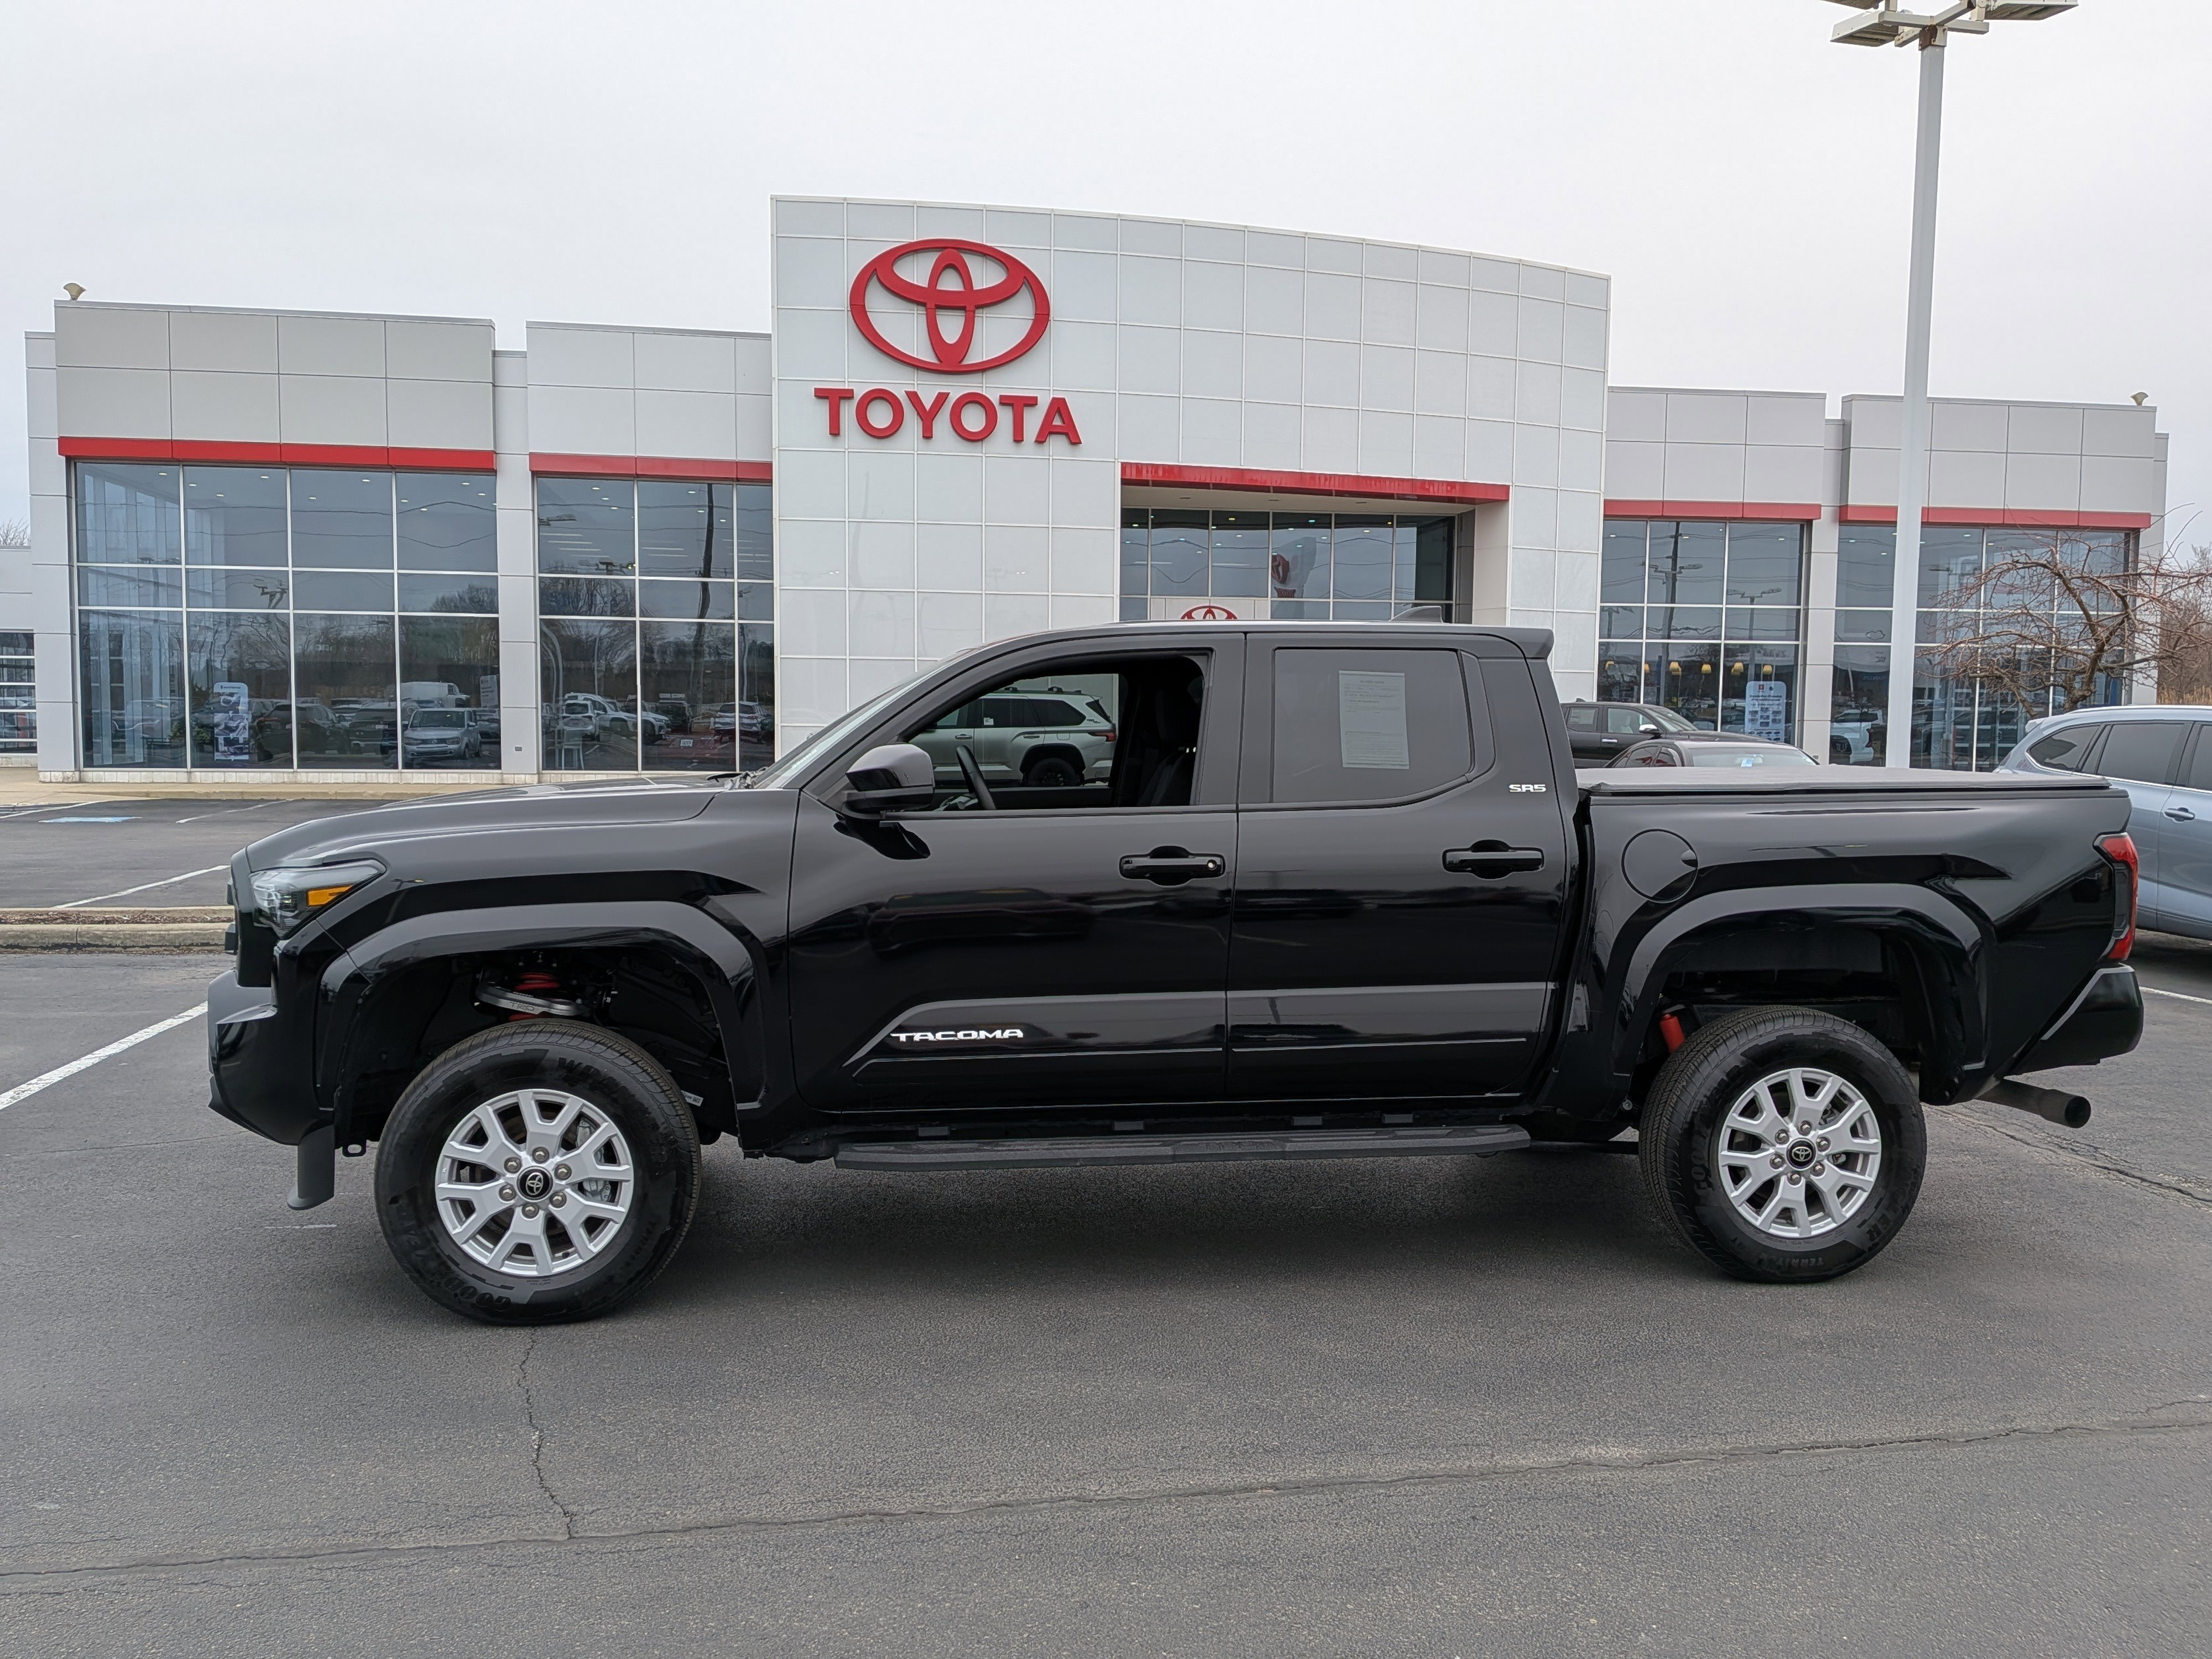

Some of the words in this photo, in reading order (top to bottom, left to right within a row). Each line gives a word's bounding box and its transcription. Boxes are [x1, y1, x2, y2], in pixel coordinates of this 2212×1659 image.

[814, 388, 1082, 445] TOYOTA
[1509, 784, 1546, 792] SR5
[509, 1001, 534, 1011] TRD
[890, 1029, 1024, 1041] TACOMA
